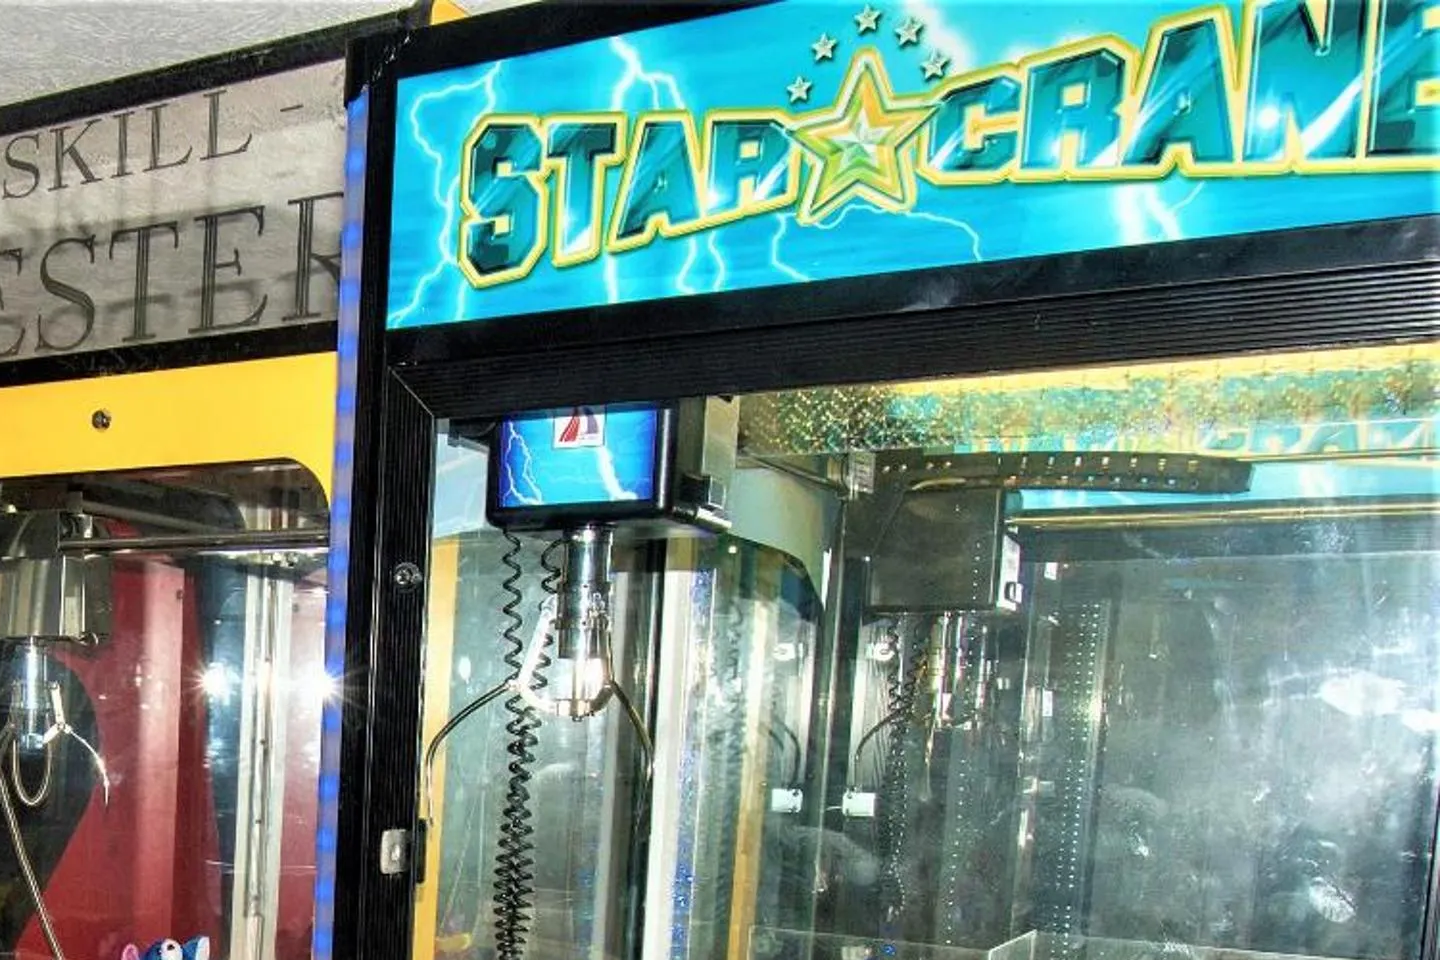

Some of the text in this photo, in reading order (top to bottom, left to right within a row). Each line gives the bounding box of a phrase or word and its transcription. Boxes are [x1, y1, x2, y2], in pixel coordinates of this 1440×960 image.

[2, 89, 253, 199] SKILL
[457, 0, 1440, 288] STAR CRANE
